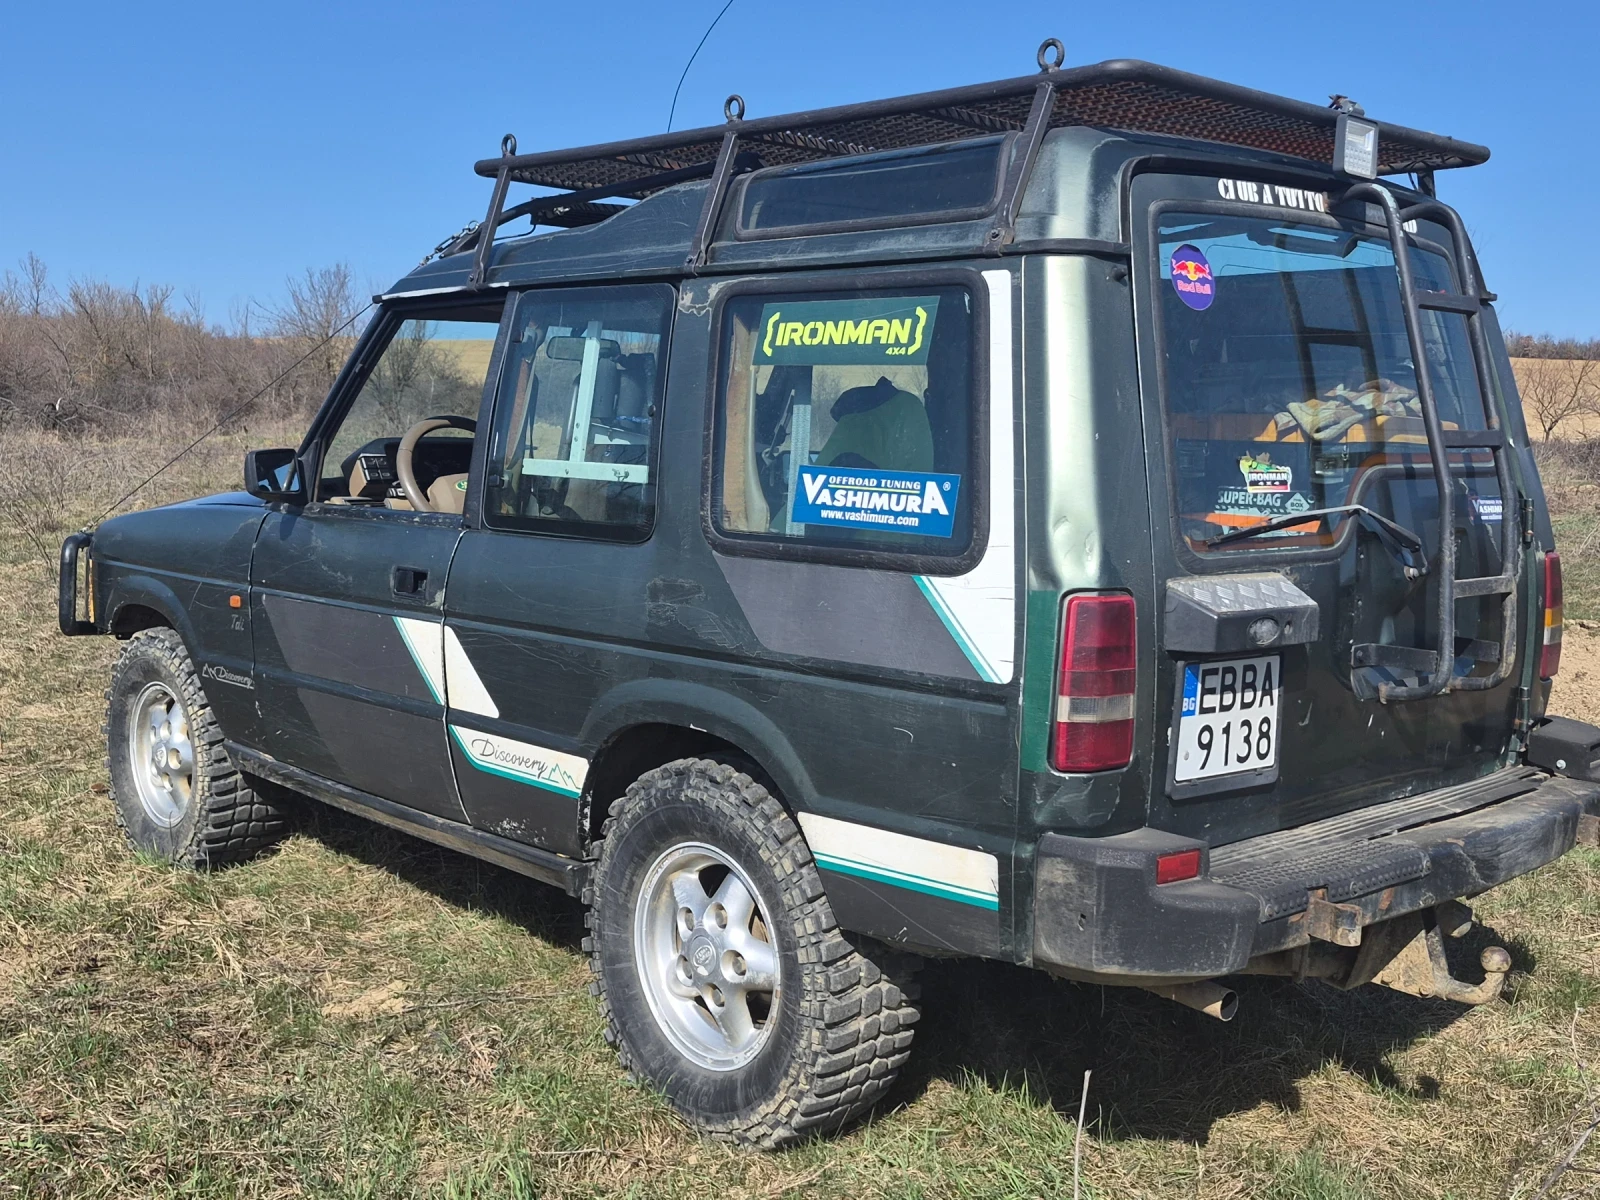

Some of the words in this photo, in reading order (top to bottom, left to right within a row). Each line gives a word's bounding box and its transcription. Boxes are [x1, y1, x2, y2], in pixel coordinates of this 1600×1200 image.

[1262, 184, 1274, 205] A
[1177, 279, 1196, 293] Red
[1194, 281, 1212, 295] Bull
[775, 318, 912, 346] IRONMAN
[828, 475, 877, 487] OFFROAD
[880, 478, 921, 490] TUNING
[1248, 472, 1288, 481] IRONMAN
[802, 472, 949, 516] VASHIMURA
[820, 509, 919, 527] www.vashimura.com
[214, 666, 255, 689] Discovery
[1198, 661, 1275, 716] EBBA
[1182, 697, 1196, 712] BG
[1197, 715, 1272, 771] 9138
[471, 738, 548, 779] Discovery
